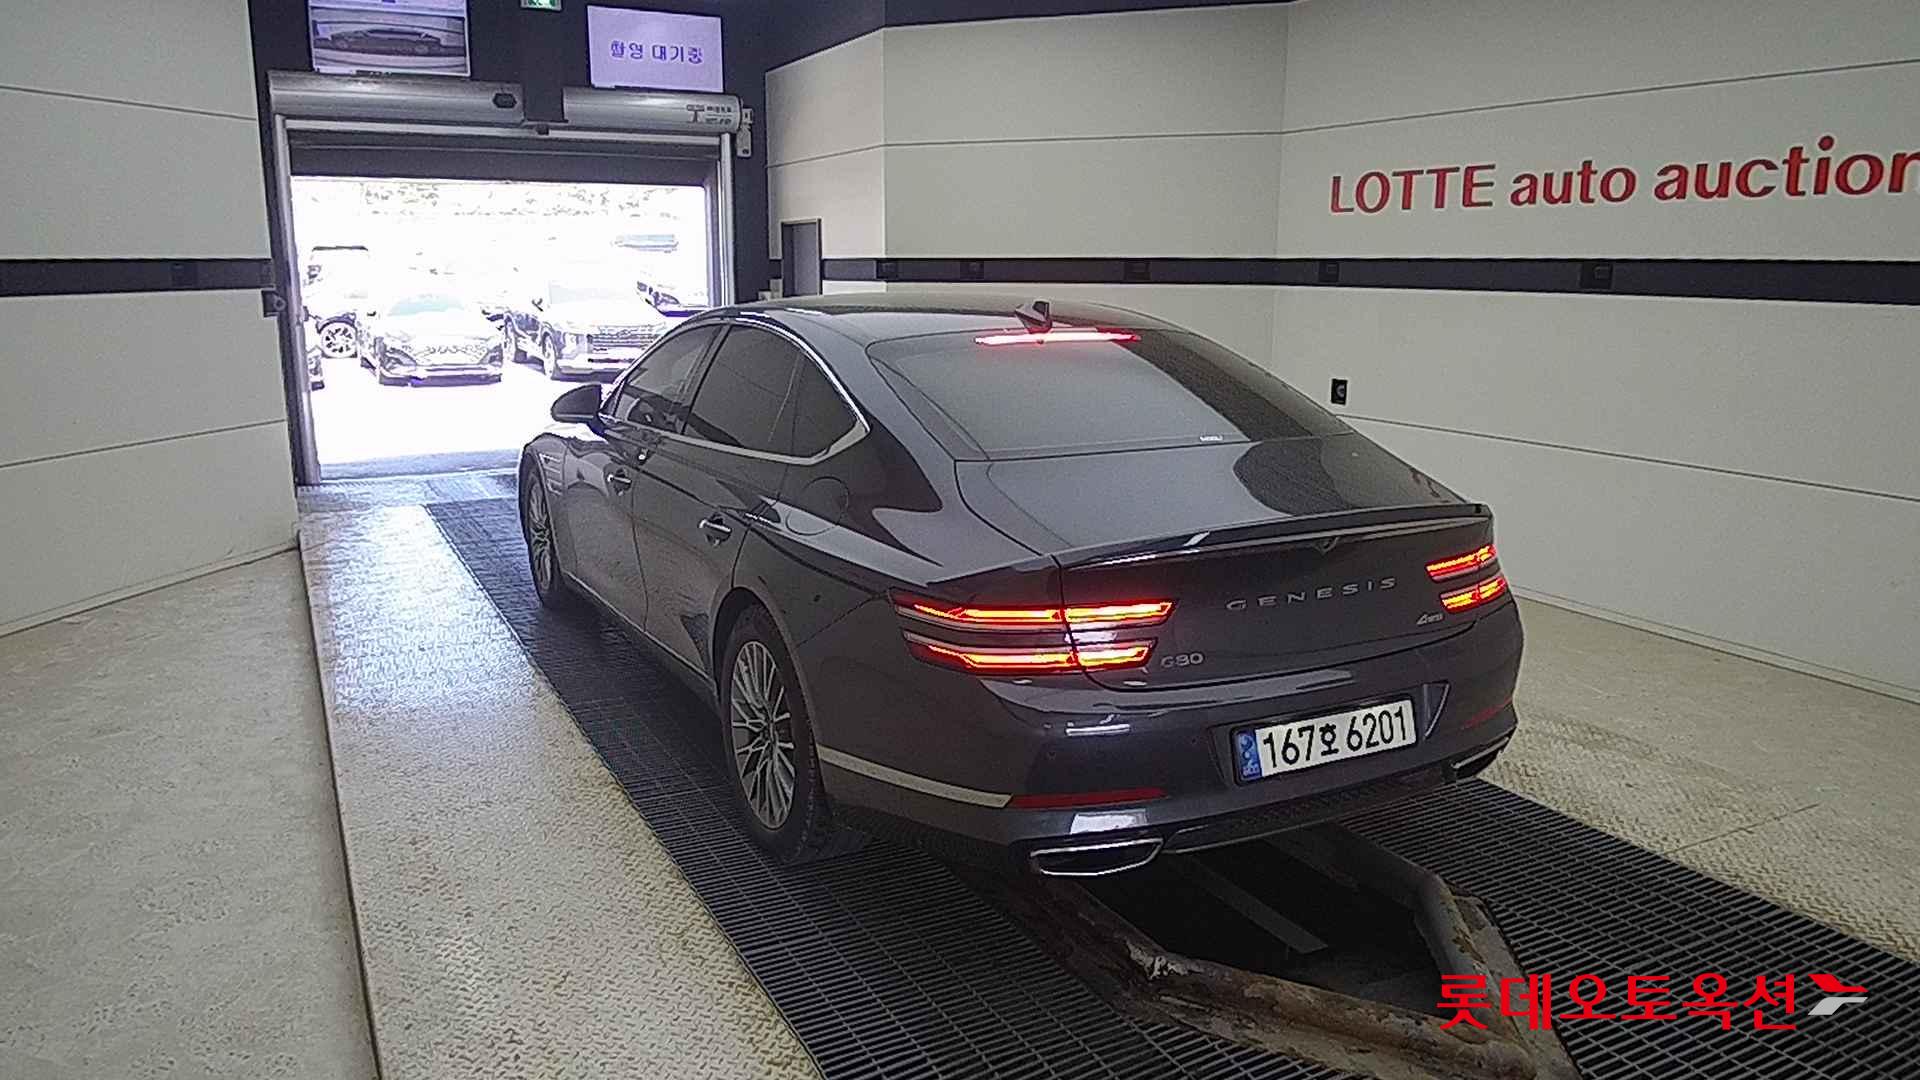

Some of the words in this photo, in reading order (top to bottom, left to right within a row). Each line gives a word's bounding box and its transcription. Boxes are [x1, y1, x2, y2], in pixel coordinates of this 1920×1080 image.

[1330, 163, 1496, 213] LOTTE
[1509, 160, 1636, 206] auto
[1226, 577, 1396, 611] GENESIS
[1346, 706, 1406, 752] 6201
